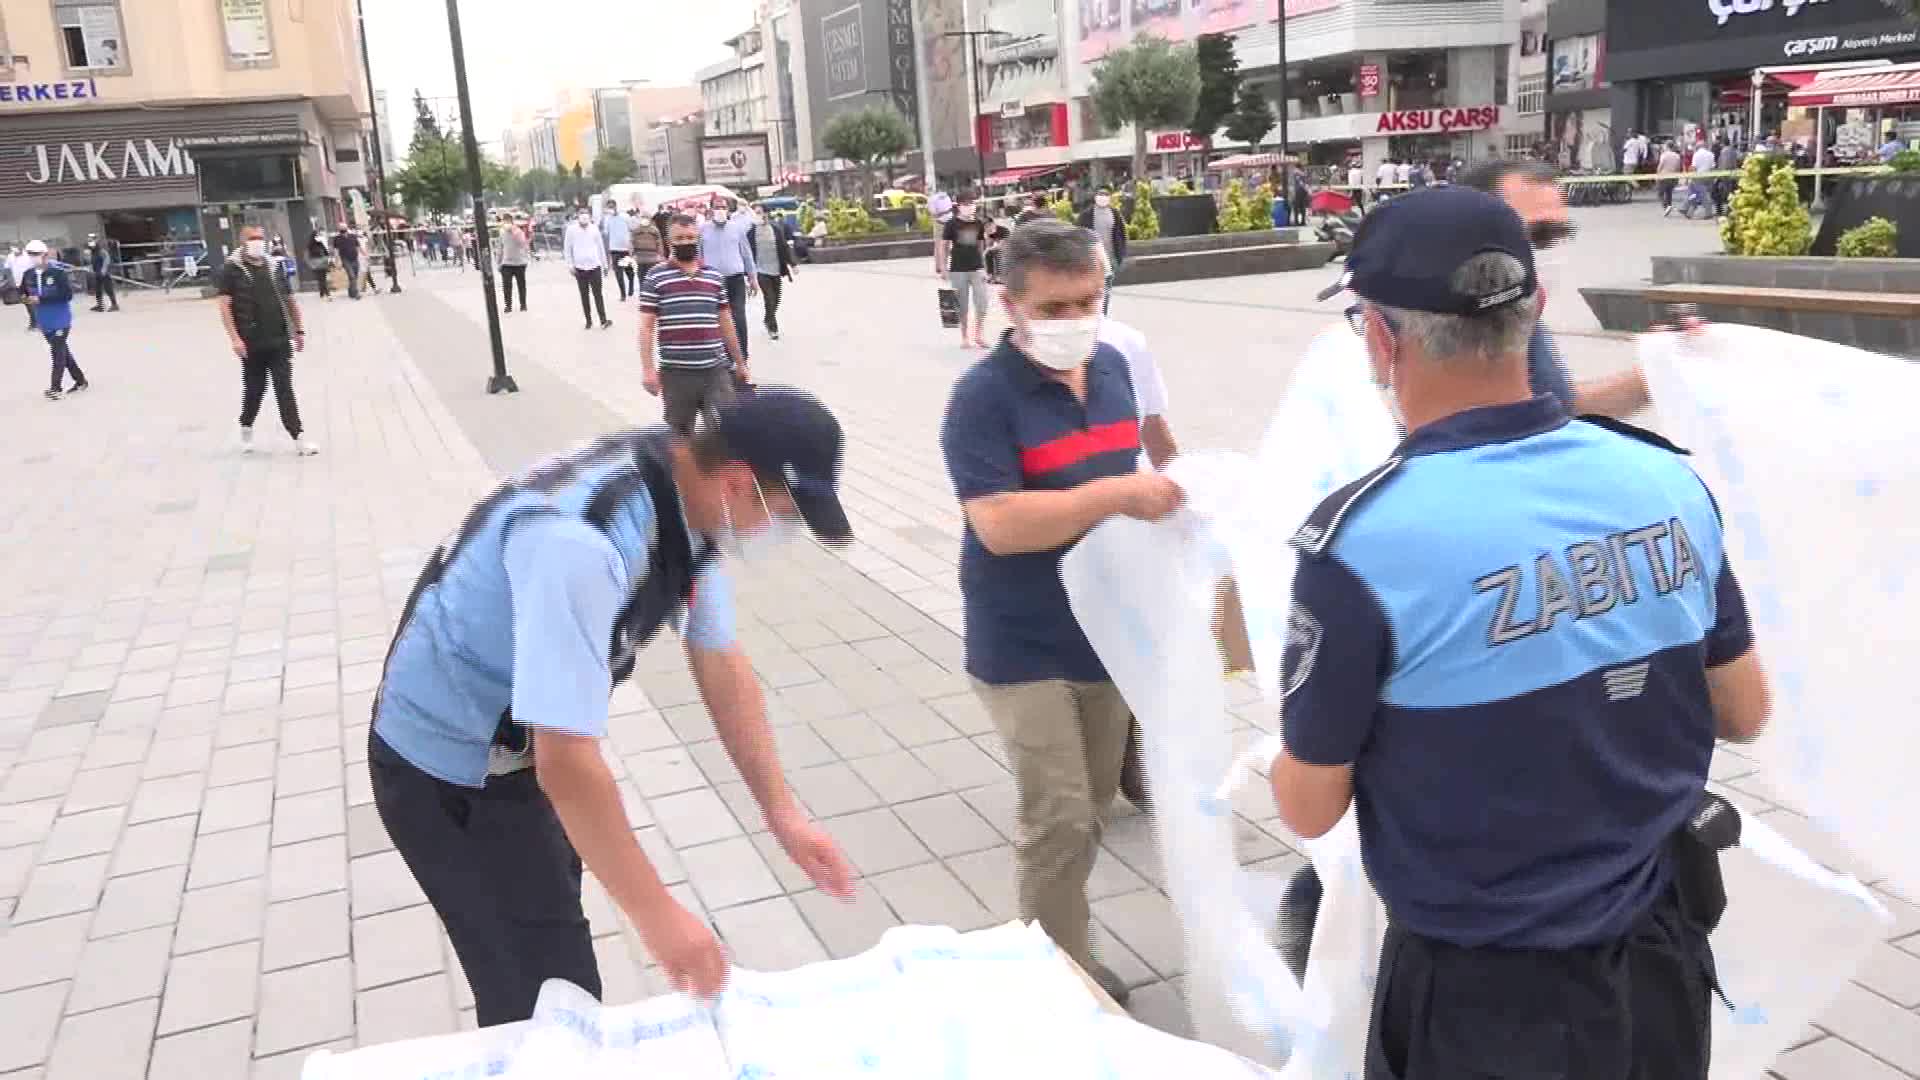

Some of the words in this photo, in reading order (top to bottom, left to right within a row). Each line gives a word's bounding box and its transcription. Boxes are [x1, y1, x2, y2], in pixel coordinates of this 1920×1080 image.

[1376, 110, 1434, 132] AKSU
[1439, 106, 1500, 134] ÇARŞI
[1472, 516, 1701, 648] ZABITA
